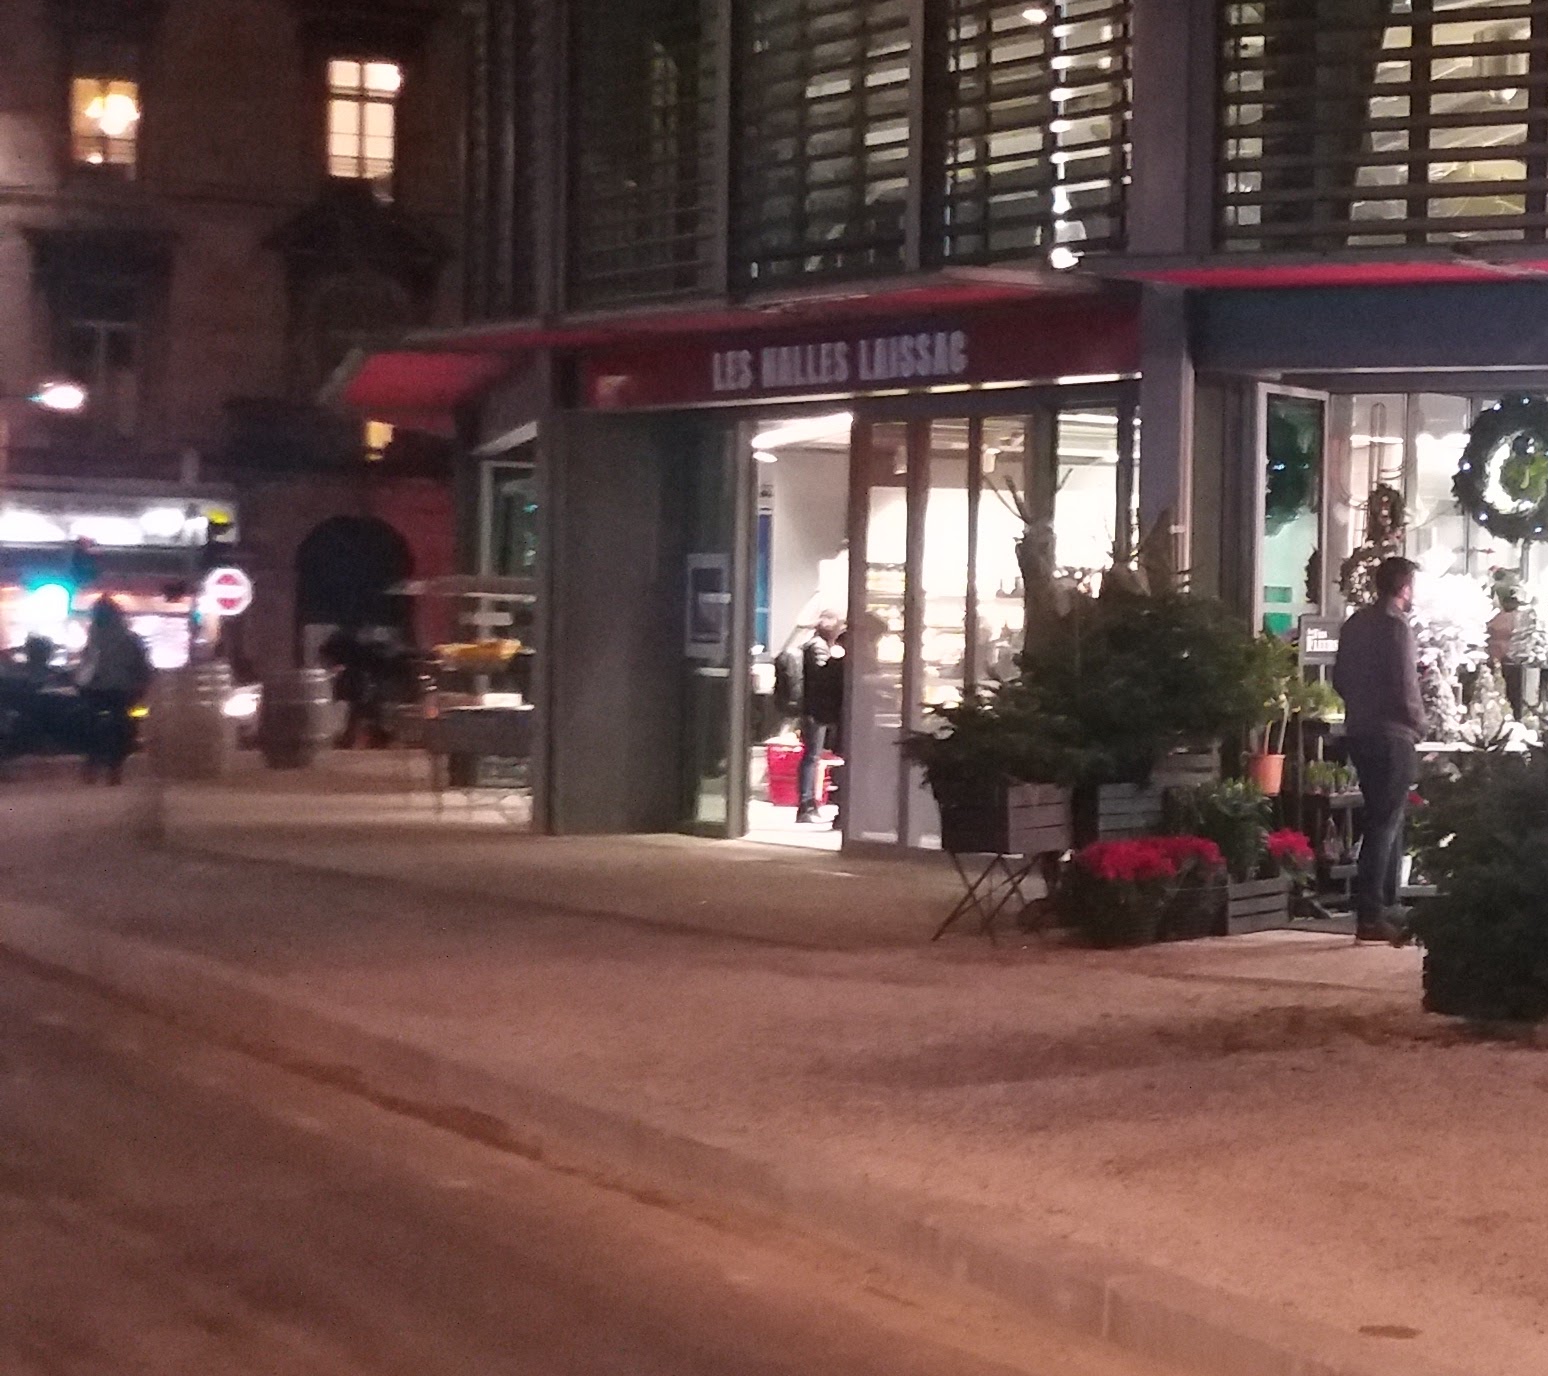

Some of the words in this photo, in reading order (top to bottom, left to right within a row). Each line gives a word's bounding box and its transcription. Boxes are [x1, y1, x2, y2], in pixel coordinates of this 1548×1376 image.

[714, 350, 753, 391] LES
[763, 342, 849, 388] HALLES
[860, 331, 968, 381] LAISSAC
